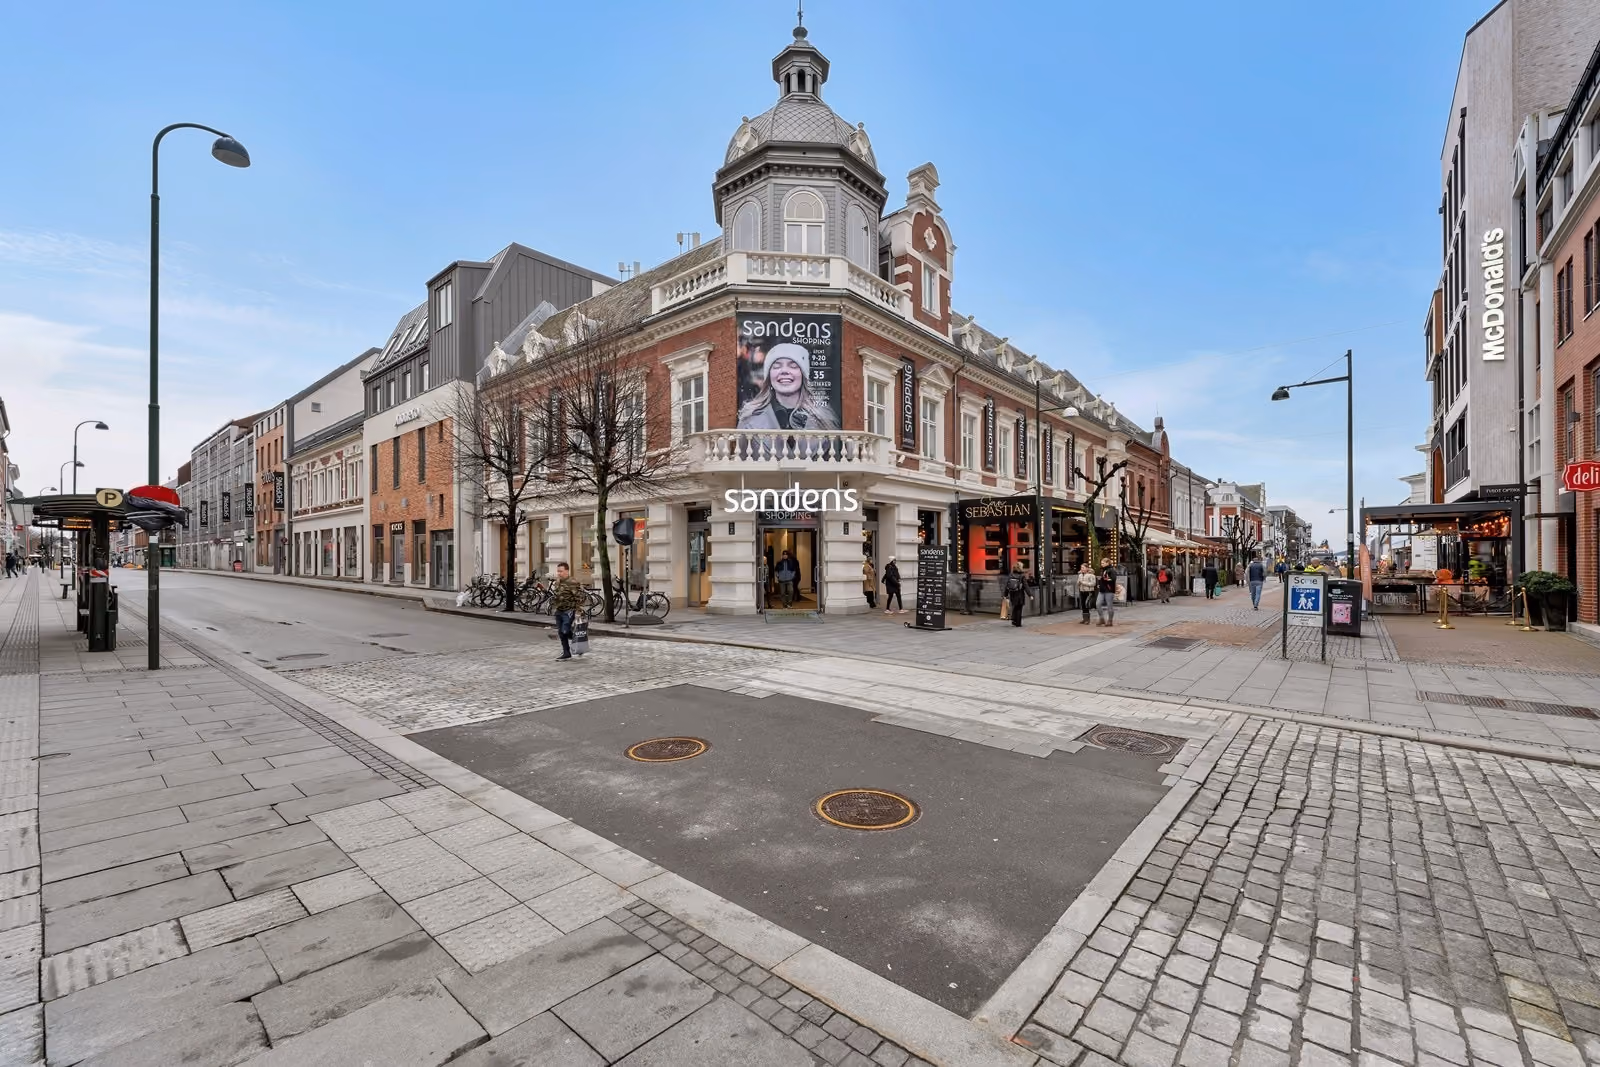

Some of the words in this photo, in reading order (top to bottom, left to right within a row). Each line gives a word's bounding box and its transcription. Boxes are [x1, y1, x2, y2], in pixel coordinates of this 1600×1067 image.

[1481, 227, 1505, 361] McDonald's
[743, 318, 831, 338] sandens
[792, 337, 831, 345] SHOPPING
[813, 370, 825, 379] 35
[904, 364, 913, 433] SHOPPING
[1572, 466, 1600, 485] deli
[105, 492, 117, 504] P
[275, 476, 283, 504] SHOPPING
[724, 482, 858, 512] sandens
[765, 511, 812, 520] SHOPPING
[965, 502, 1031, 518] SEBASTIÁN
[391, 523, 403, 531] KICKS
[920, 548, 945, 556] sandens
